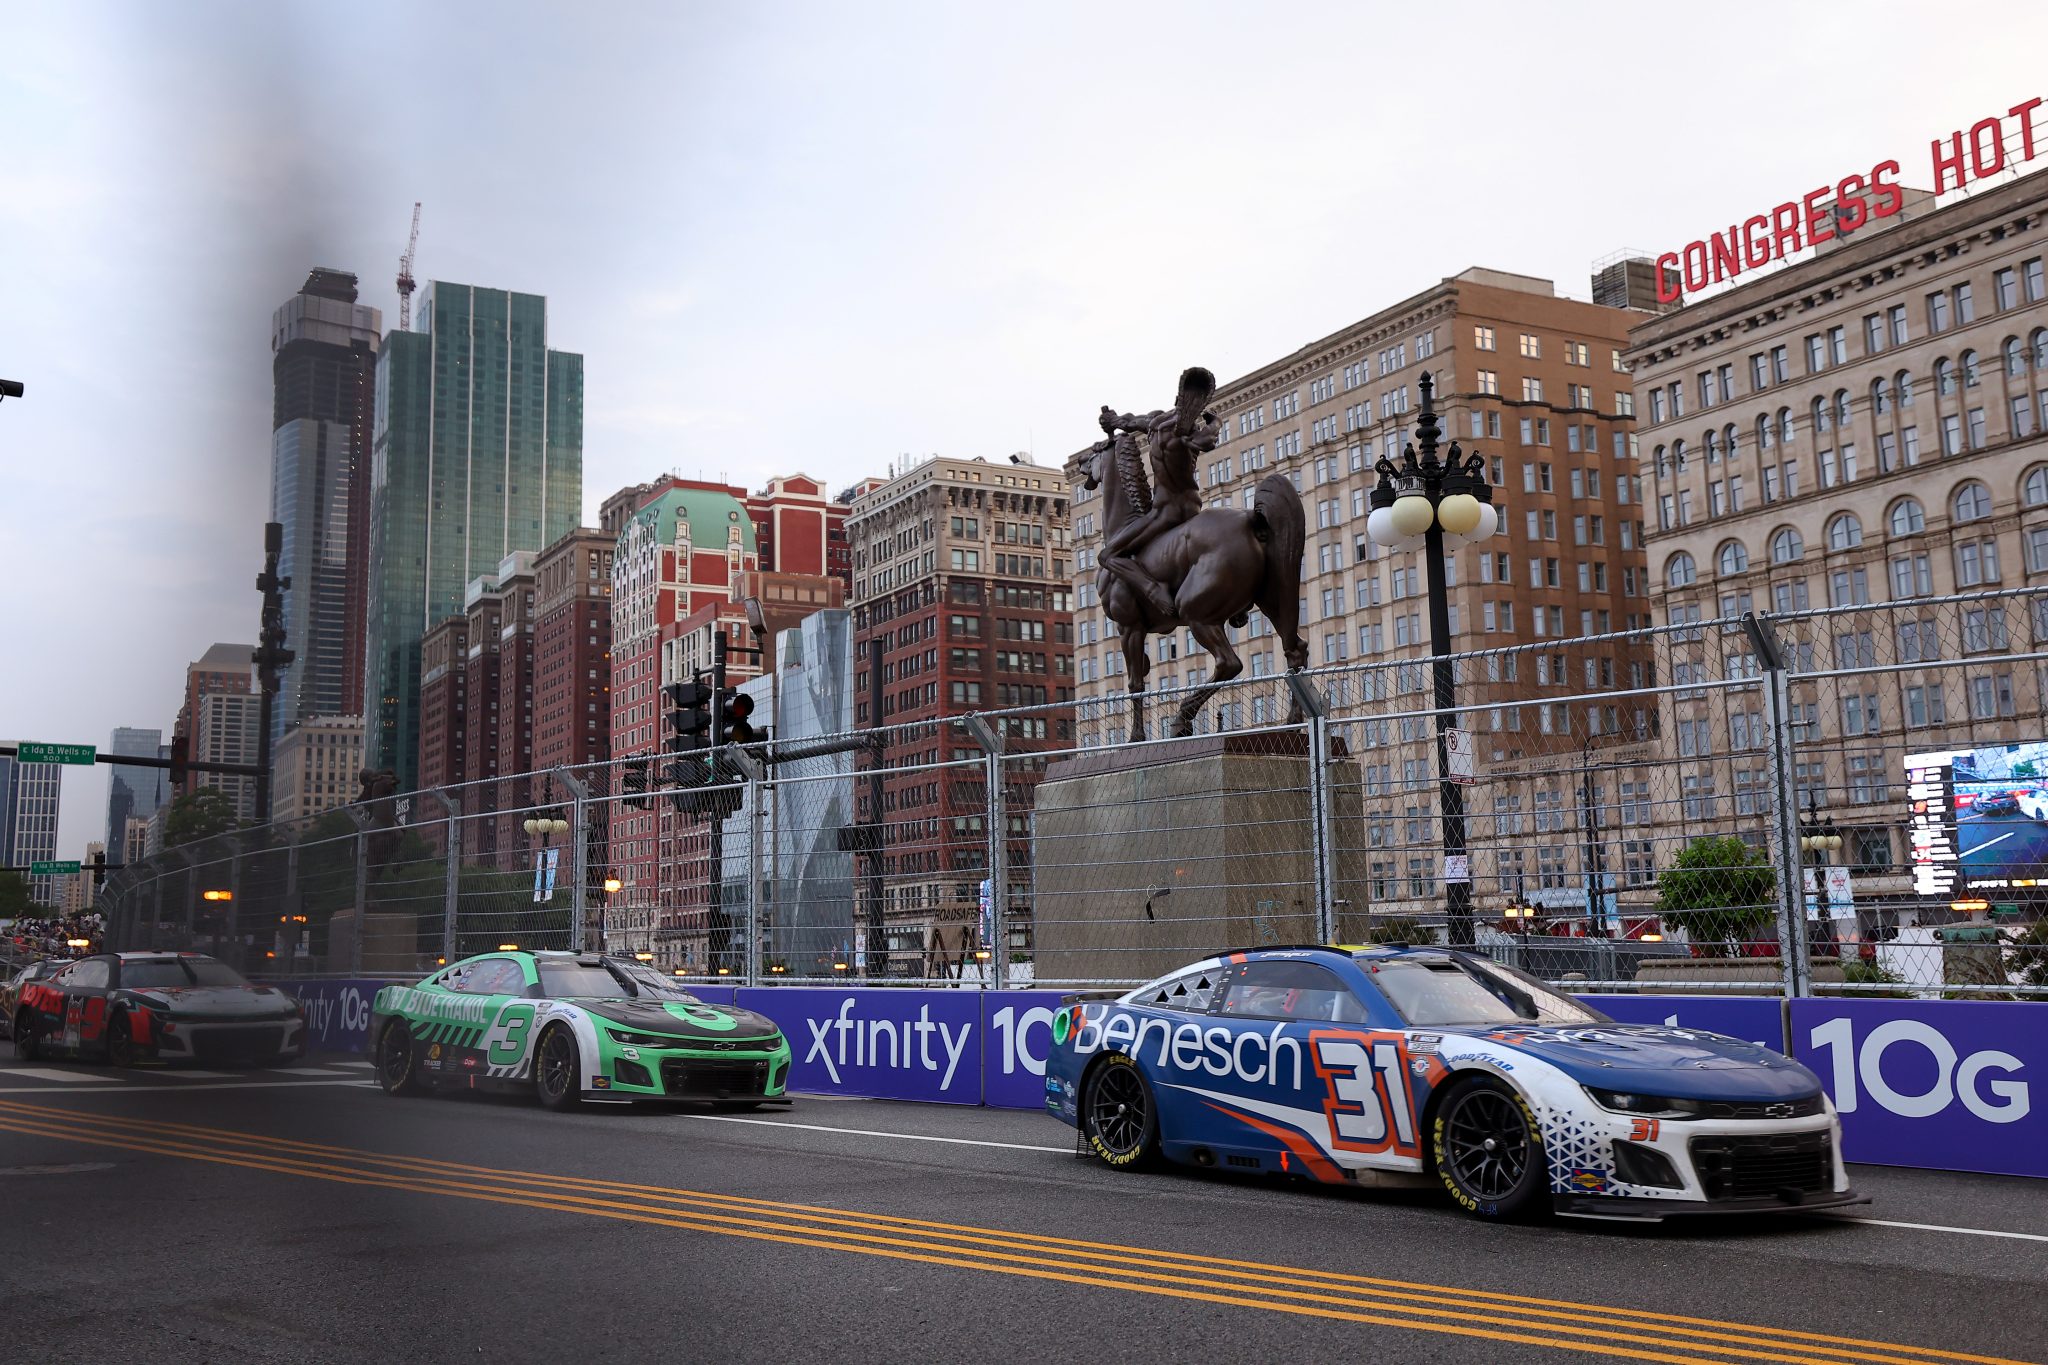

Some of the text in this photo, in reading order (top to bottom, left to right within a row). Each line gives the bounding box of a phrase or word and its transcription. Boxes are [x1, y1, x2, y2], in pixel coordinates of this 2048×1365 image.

[1655, 97, 2042, 304] CONGRESS HOT
[31, 745, 44, 754] Ida
[57, 747, 80, 756] Wells
[340, 987, 369, 1031] 10G
[404, 990, 490, 1024] BIOETHANOL
[488, 1003, 535, 1066] 3
[621, 1047, 641, 1062] 3
[804, 997, 973, 1091] xfinity
[1073, 1003, 1302, 1091] Benesch
[1810, 1017, 2031, 1124] 10G
[1314, 1037, 1417, 1148] 31
[1630, 1118, 1661, 1143] 31
